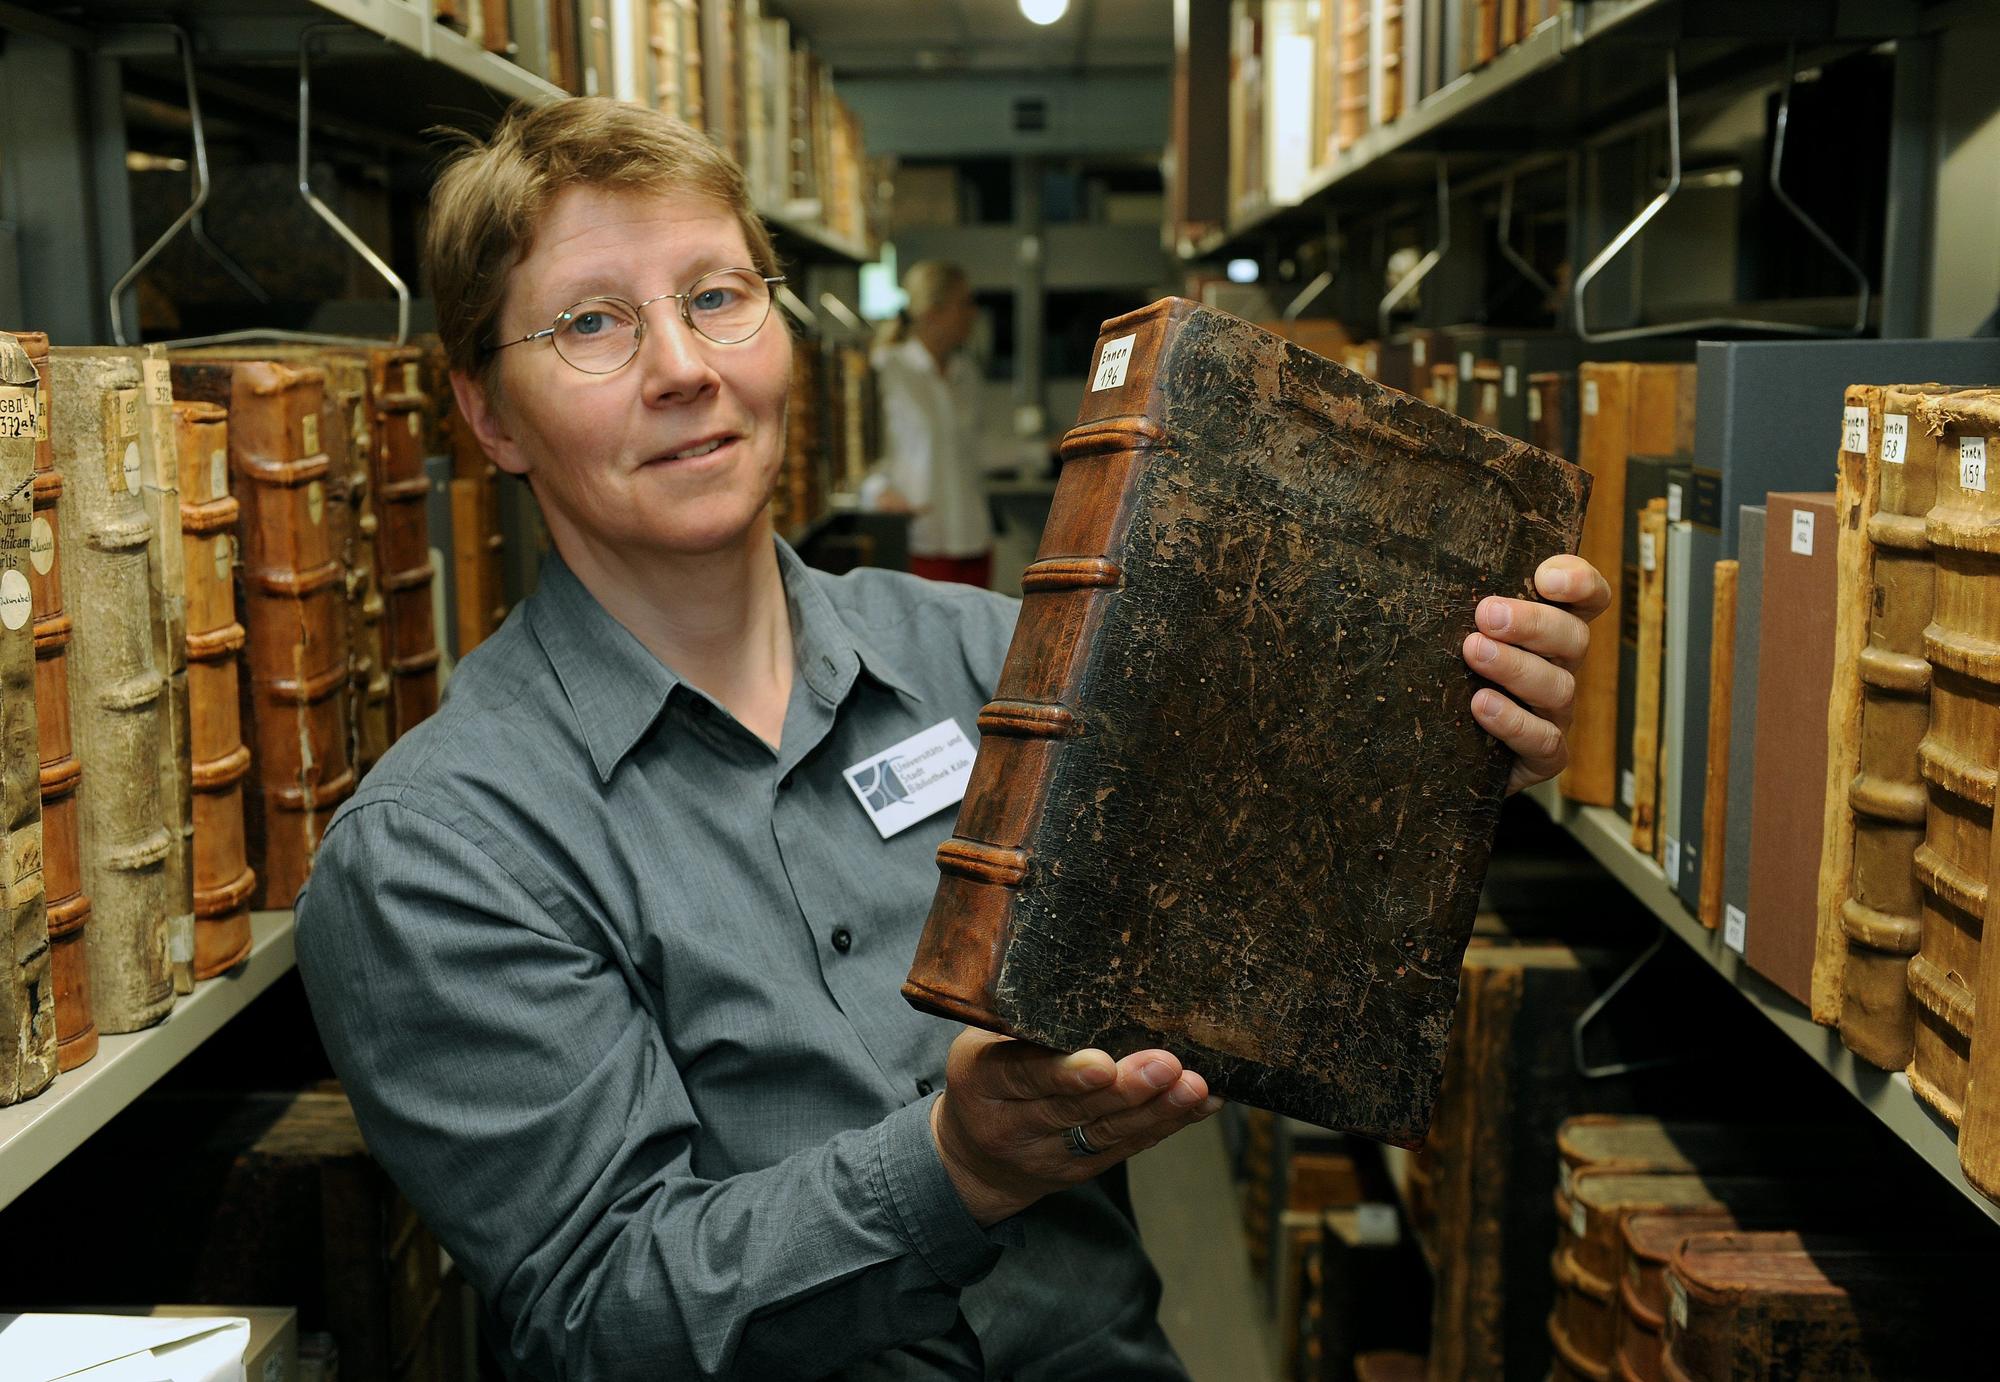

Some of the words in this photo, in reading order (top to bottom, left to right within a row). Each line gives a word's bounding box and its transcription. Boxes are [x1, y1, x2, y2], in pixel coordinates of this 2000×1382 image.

[1101, 364, 1119, 387] 196
[1962, 444, 1981, 460] Ennen
[1963, 464, 1979, 486] 159
[900, 766, 926, 781] Stadt
